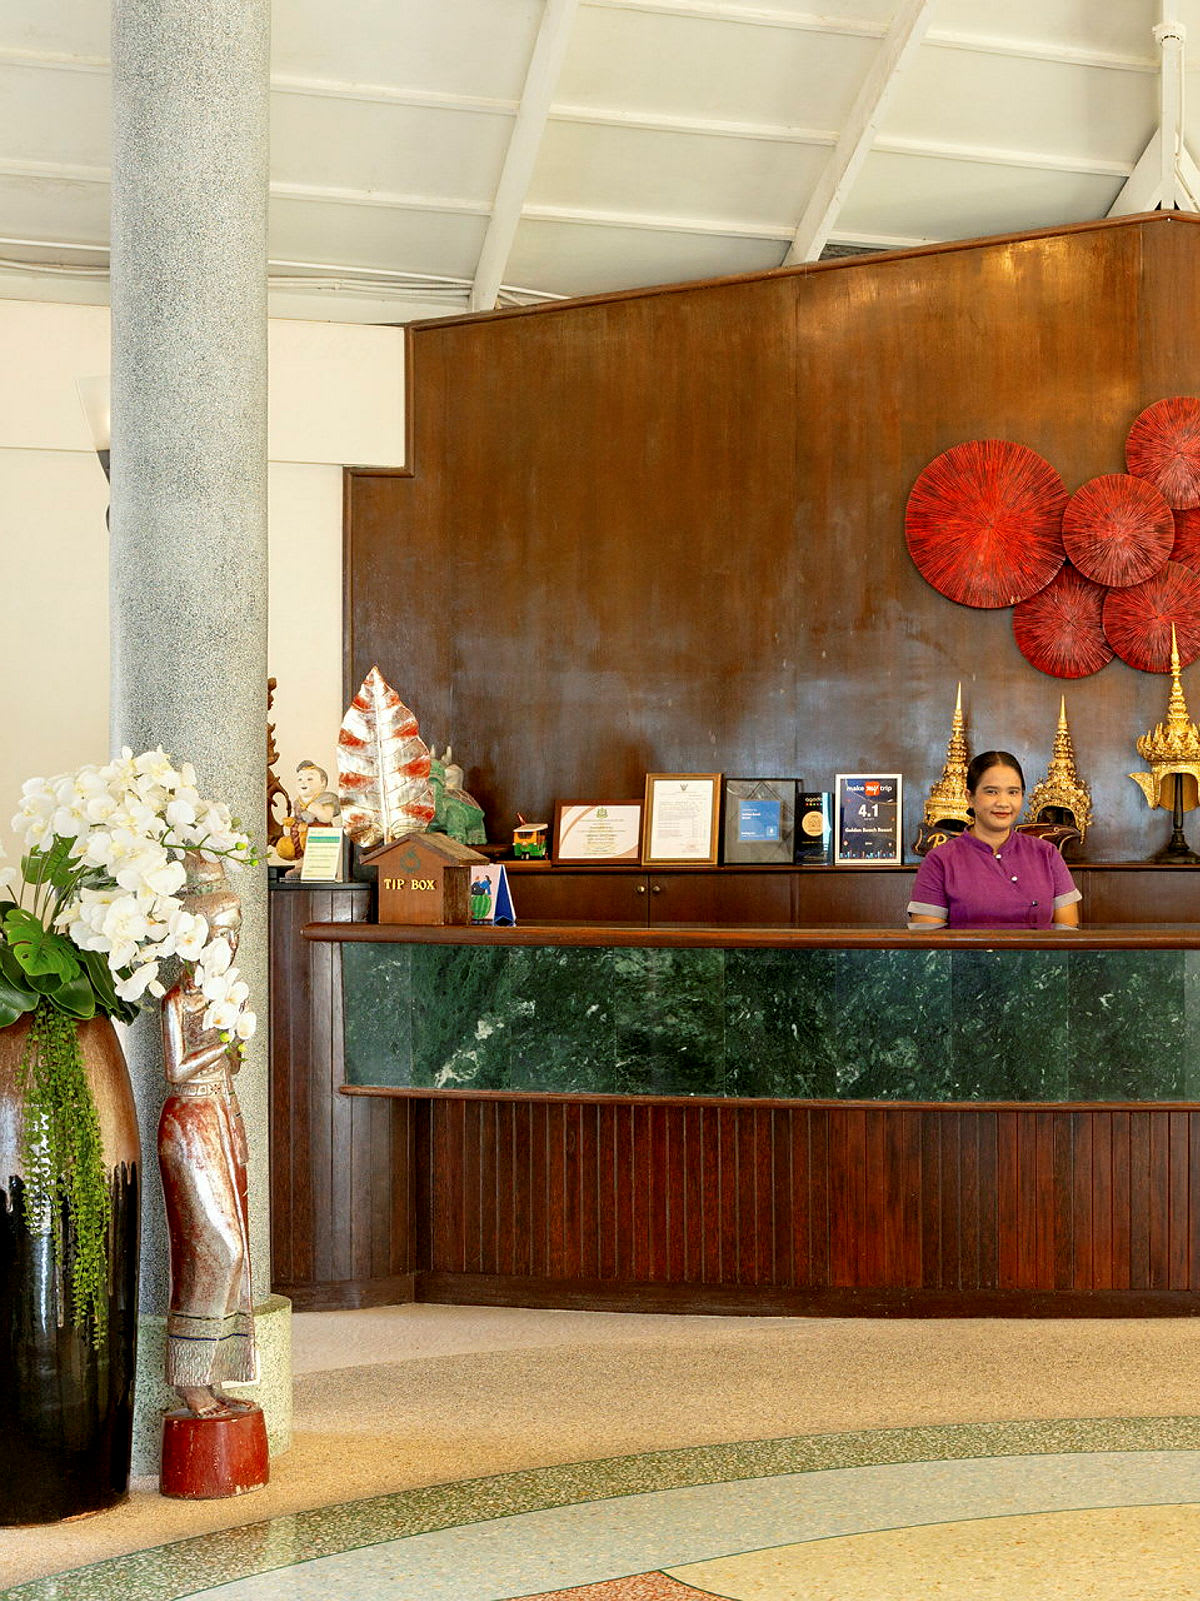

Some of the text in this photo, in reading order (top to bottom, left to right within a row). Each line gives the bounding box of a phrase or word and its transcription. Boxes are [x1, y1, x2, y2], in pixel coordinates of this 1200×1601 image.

[858, 804, 879, 818] 4.1
[383, 878, 435, 891] TIP BOX
